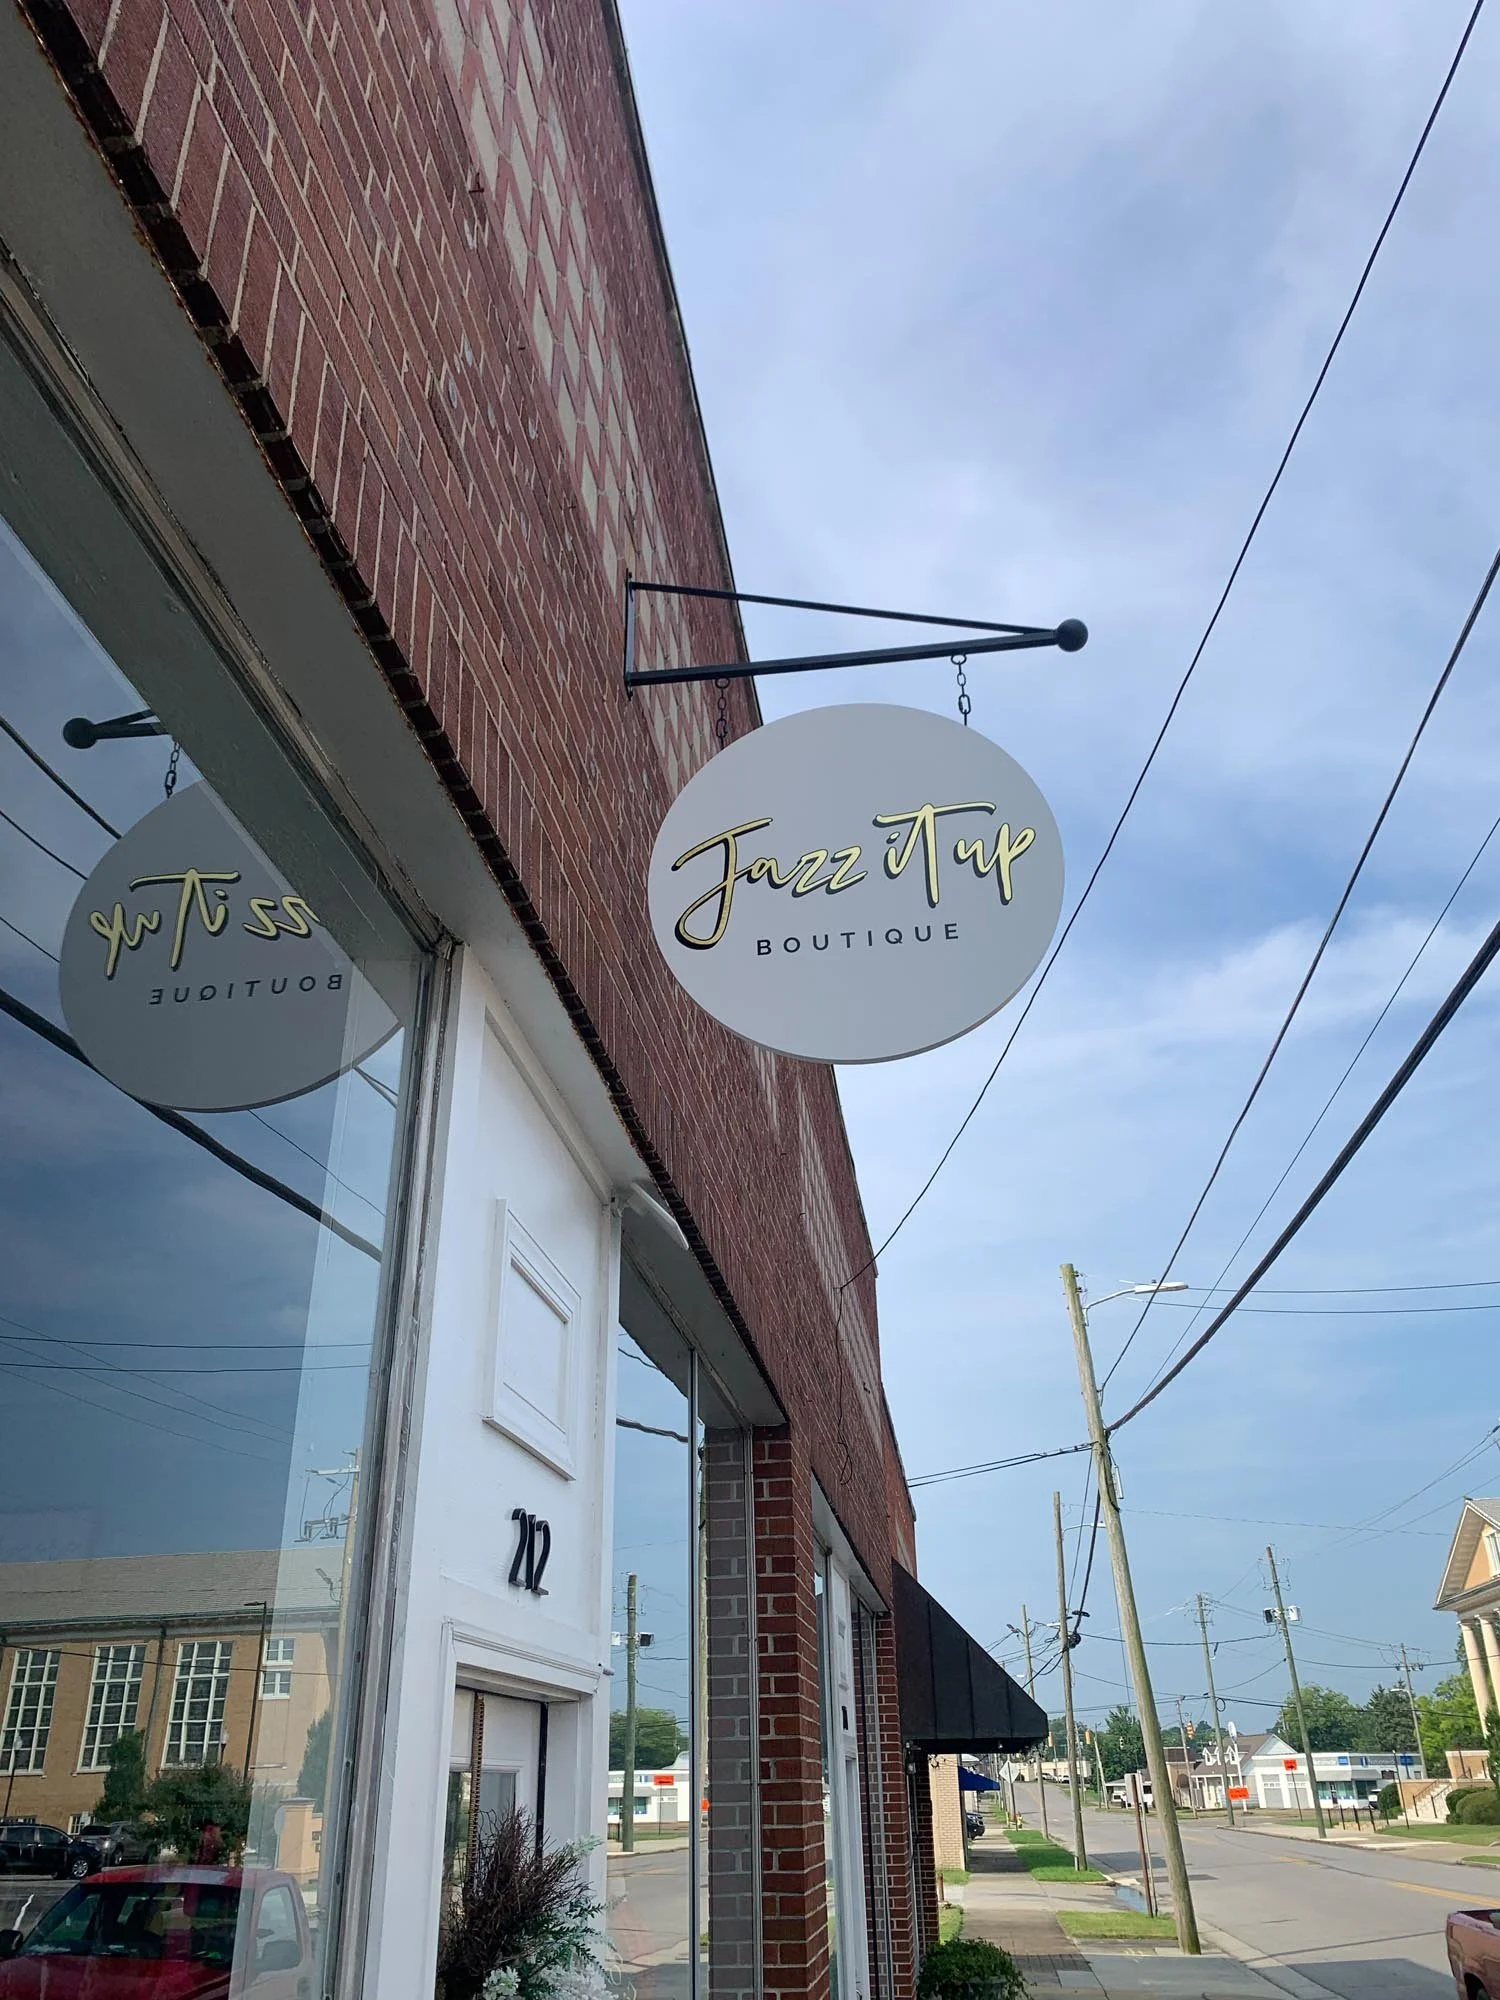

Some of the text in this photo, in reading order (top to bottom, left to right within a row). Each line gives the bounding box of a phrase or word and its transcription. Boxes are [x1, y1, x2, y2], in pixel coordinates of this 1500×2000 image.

[671, 817, 868, 950] Jazz
[953, 823, 1036, 905] up
[756, 922, 959, 956] BOUTIQUE
